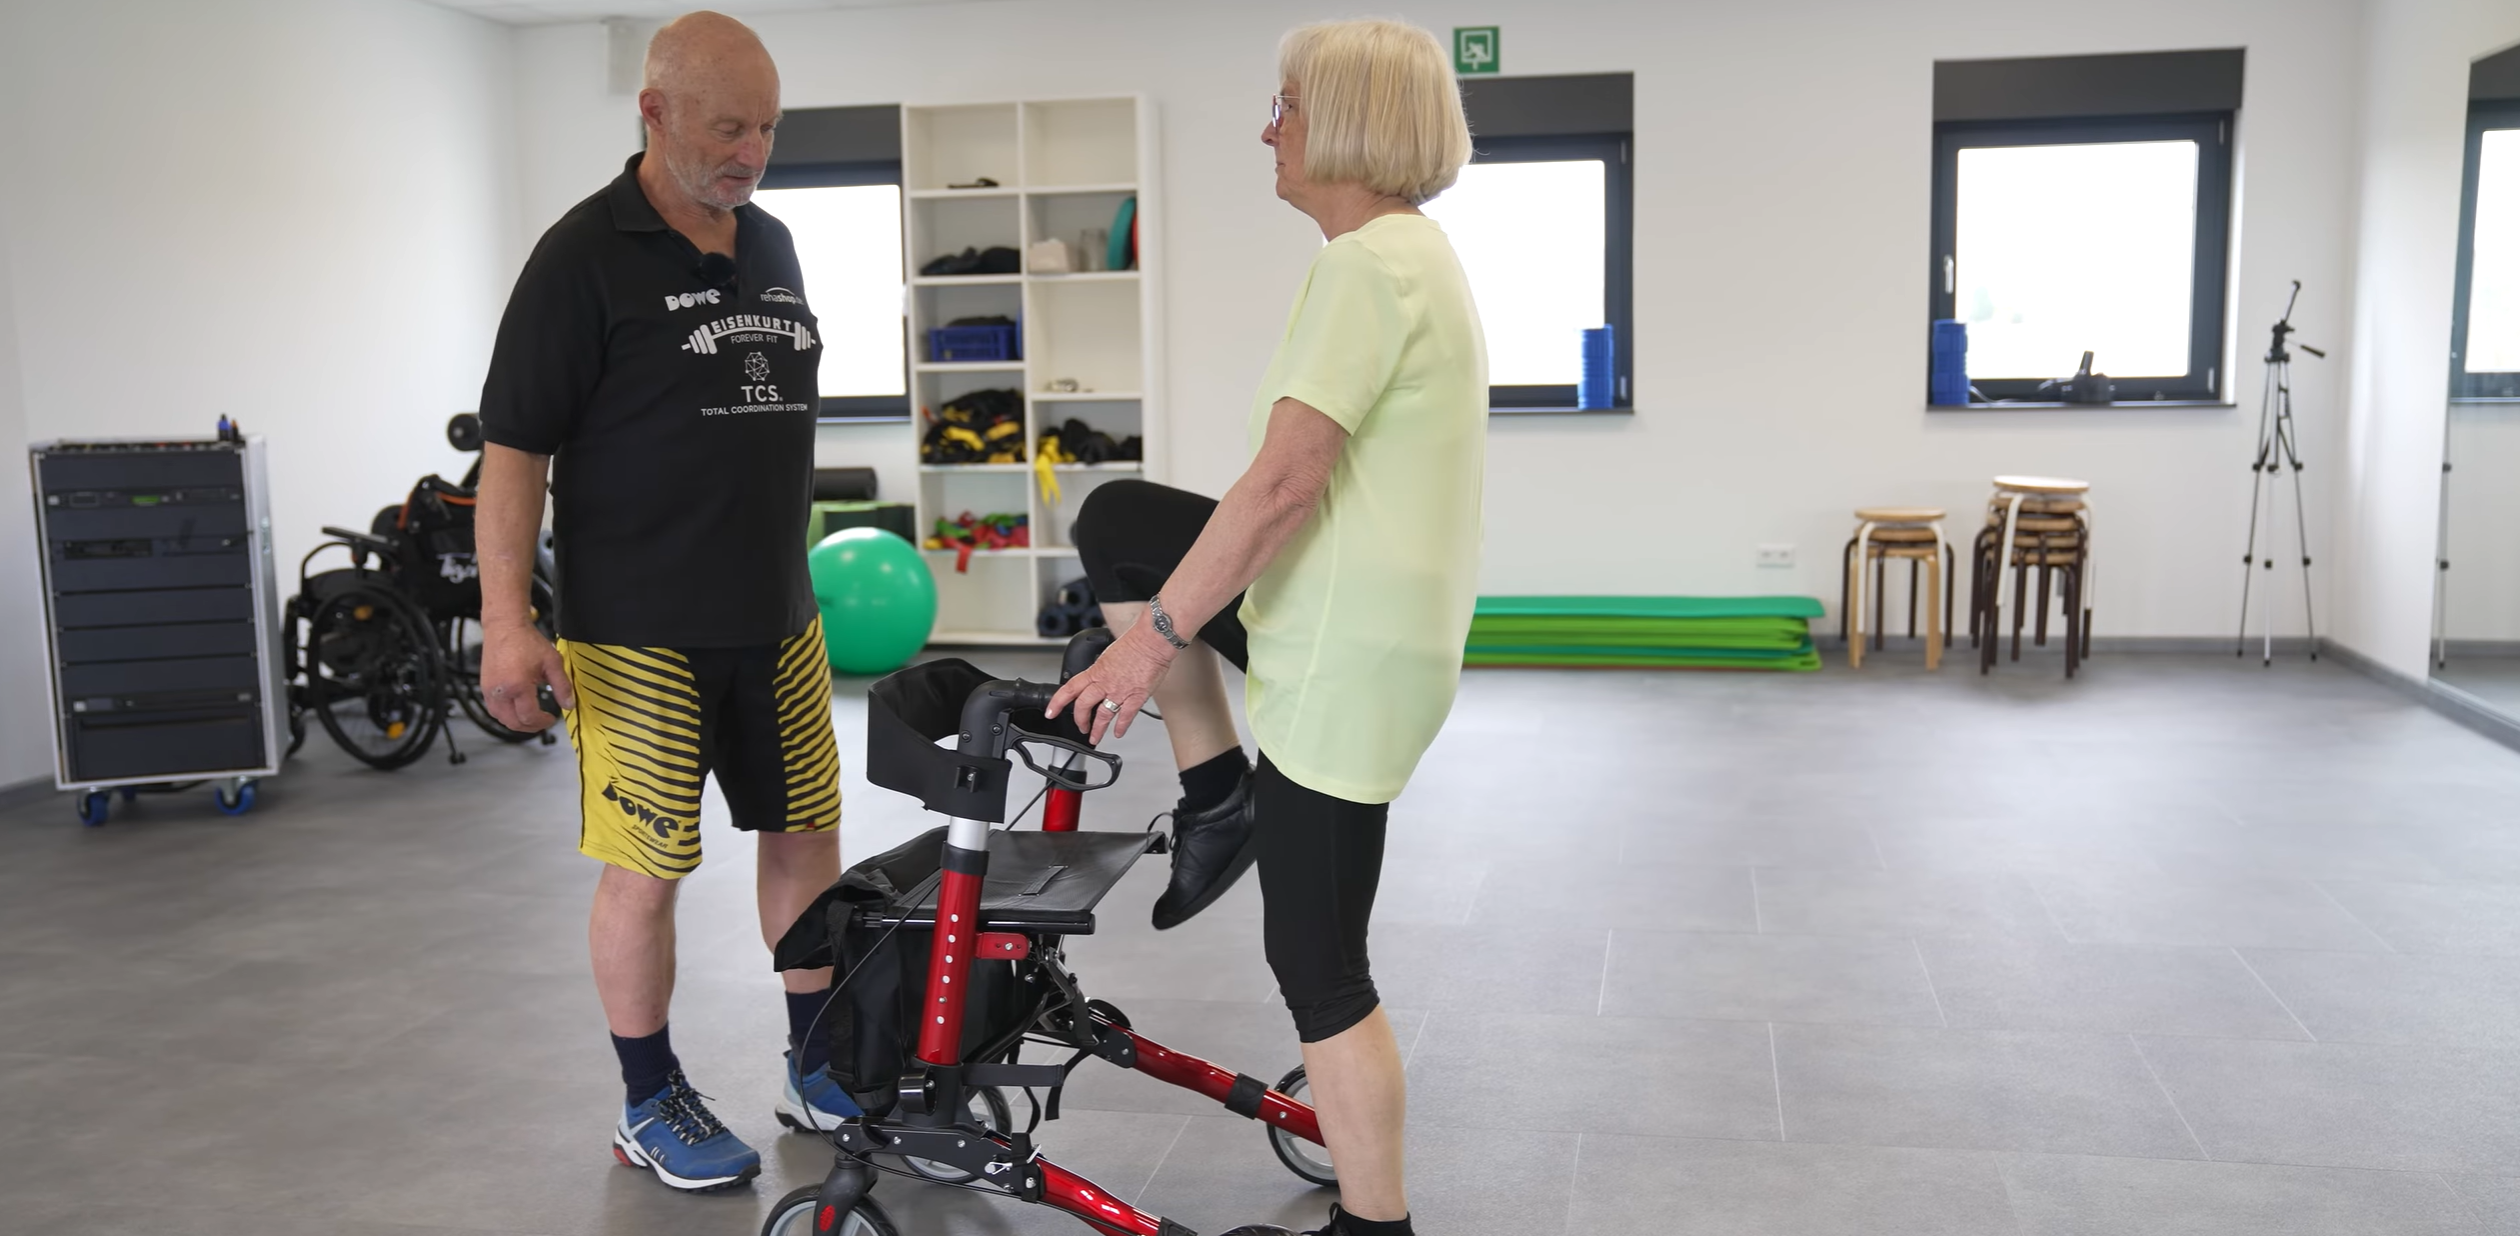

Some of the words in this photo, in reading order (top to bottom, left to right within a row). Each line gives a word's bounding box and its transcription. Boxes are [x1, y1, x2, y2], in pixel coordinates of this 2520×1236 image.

[711, 314, 791, 333] EISENKURT
[731, 333, 764, 344] FOREVER
[766, 334, 778, 343] FIT
[701, 407, 729, 416] TOTAL
[731, 404, 784, 414] COORDINATION
[785, 403, 808, 412] SYSTEM
